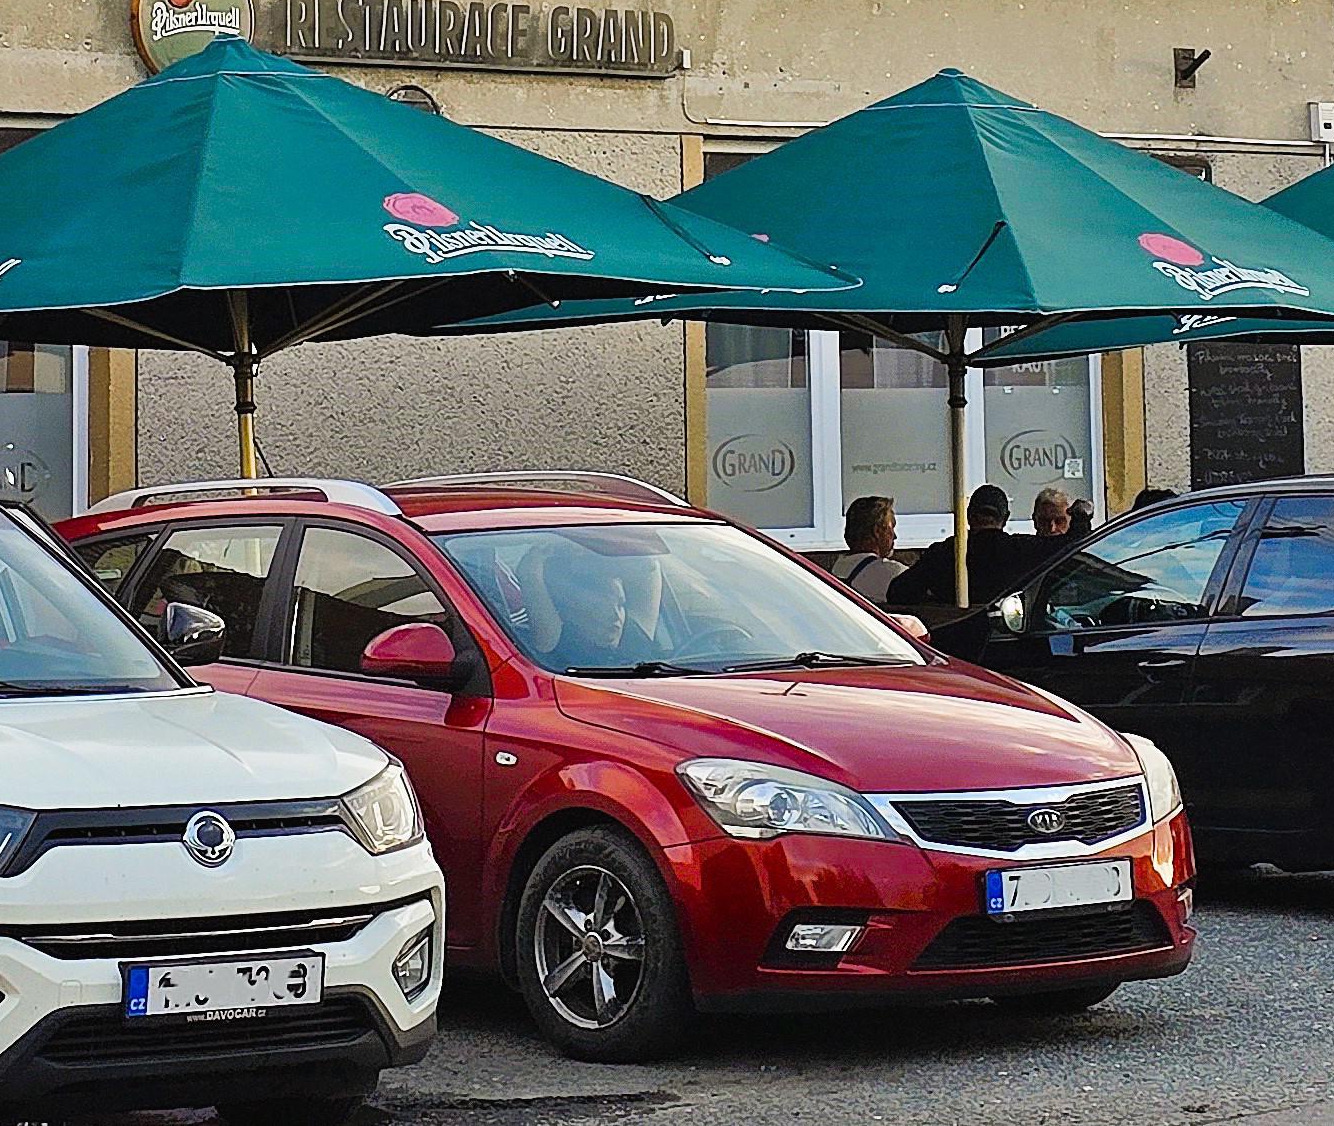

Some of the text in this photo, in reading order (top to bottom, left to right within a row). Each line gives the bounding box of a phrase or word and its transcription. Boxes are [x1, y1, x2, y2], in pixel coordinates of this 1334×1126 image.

[151, 1, 240, 42] Pilsner Urquell
[547, 5, 675, 64] GRAND
[383, 221, 592, 264] Pilsner Urquell
[722, 449, 786, 478] GRAND
[1009, 443, 1068, 471] GRAND
[990, 898, 1003, 909] CZ
[130, 998, 146, 1011] CZ
